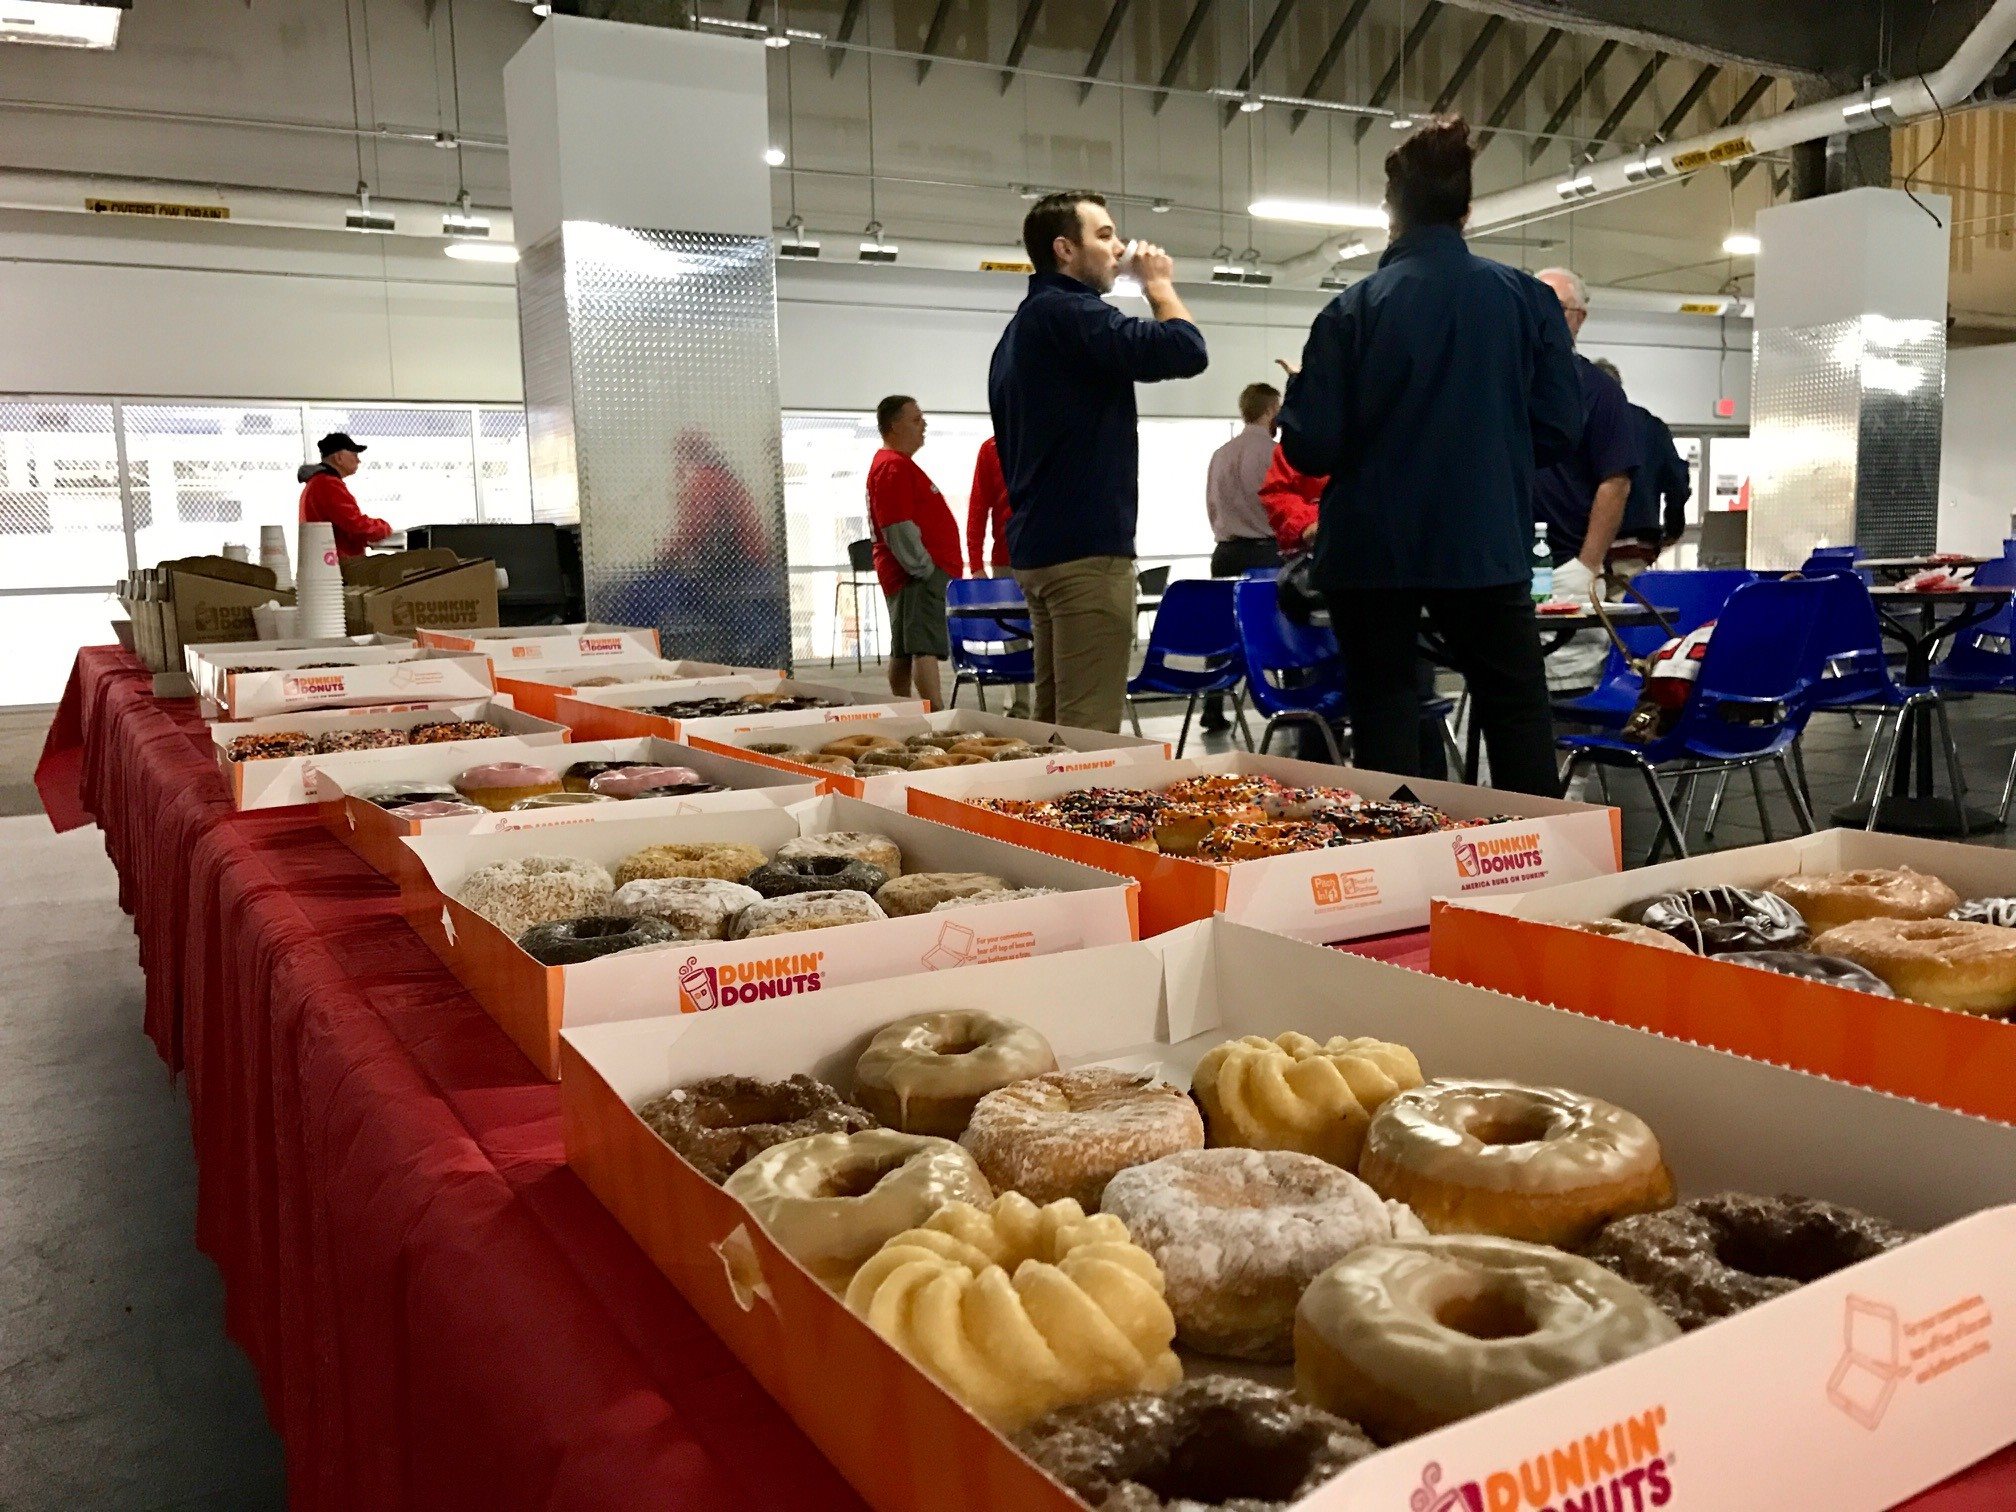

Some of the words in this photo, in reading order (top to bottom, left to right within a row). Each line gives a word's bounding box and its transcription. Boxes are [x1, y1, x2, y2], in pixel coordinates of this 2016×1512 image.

[219, 605, 254, 618] DUN
[414, 599, 481, 613] DUNKIN'
[416, 612, 478, 625] DONUTS
[591, 644, 622, 652] DONUTS
[300, 674, 345, 685] DUNKIN'
[301, 682, 345, 694] DONUTS
[1478, 833, 1541, 857] DUNKIN'
[1480, 850, 1543, 875] DONUTS
[1461, 880, 1491, 891] AMERICA
[1492, 877, 1509, 887] RUNS
[1510, 875, 1520, 883] ON
[987, 936, 999, 945] your
[999, 944, 1008, 952] top
[1009, 942, 1016, 950] of
[1026, 938, 1036, 947] and
[718, 951, 824, 986] DUNKIN'
[721, 972, 822, 1007] DONUTS
[1486, 1405, 1667, 1512] DUNKIN'
